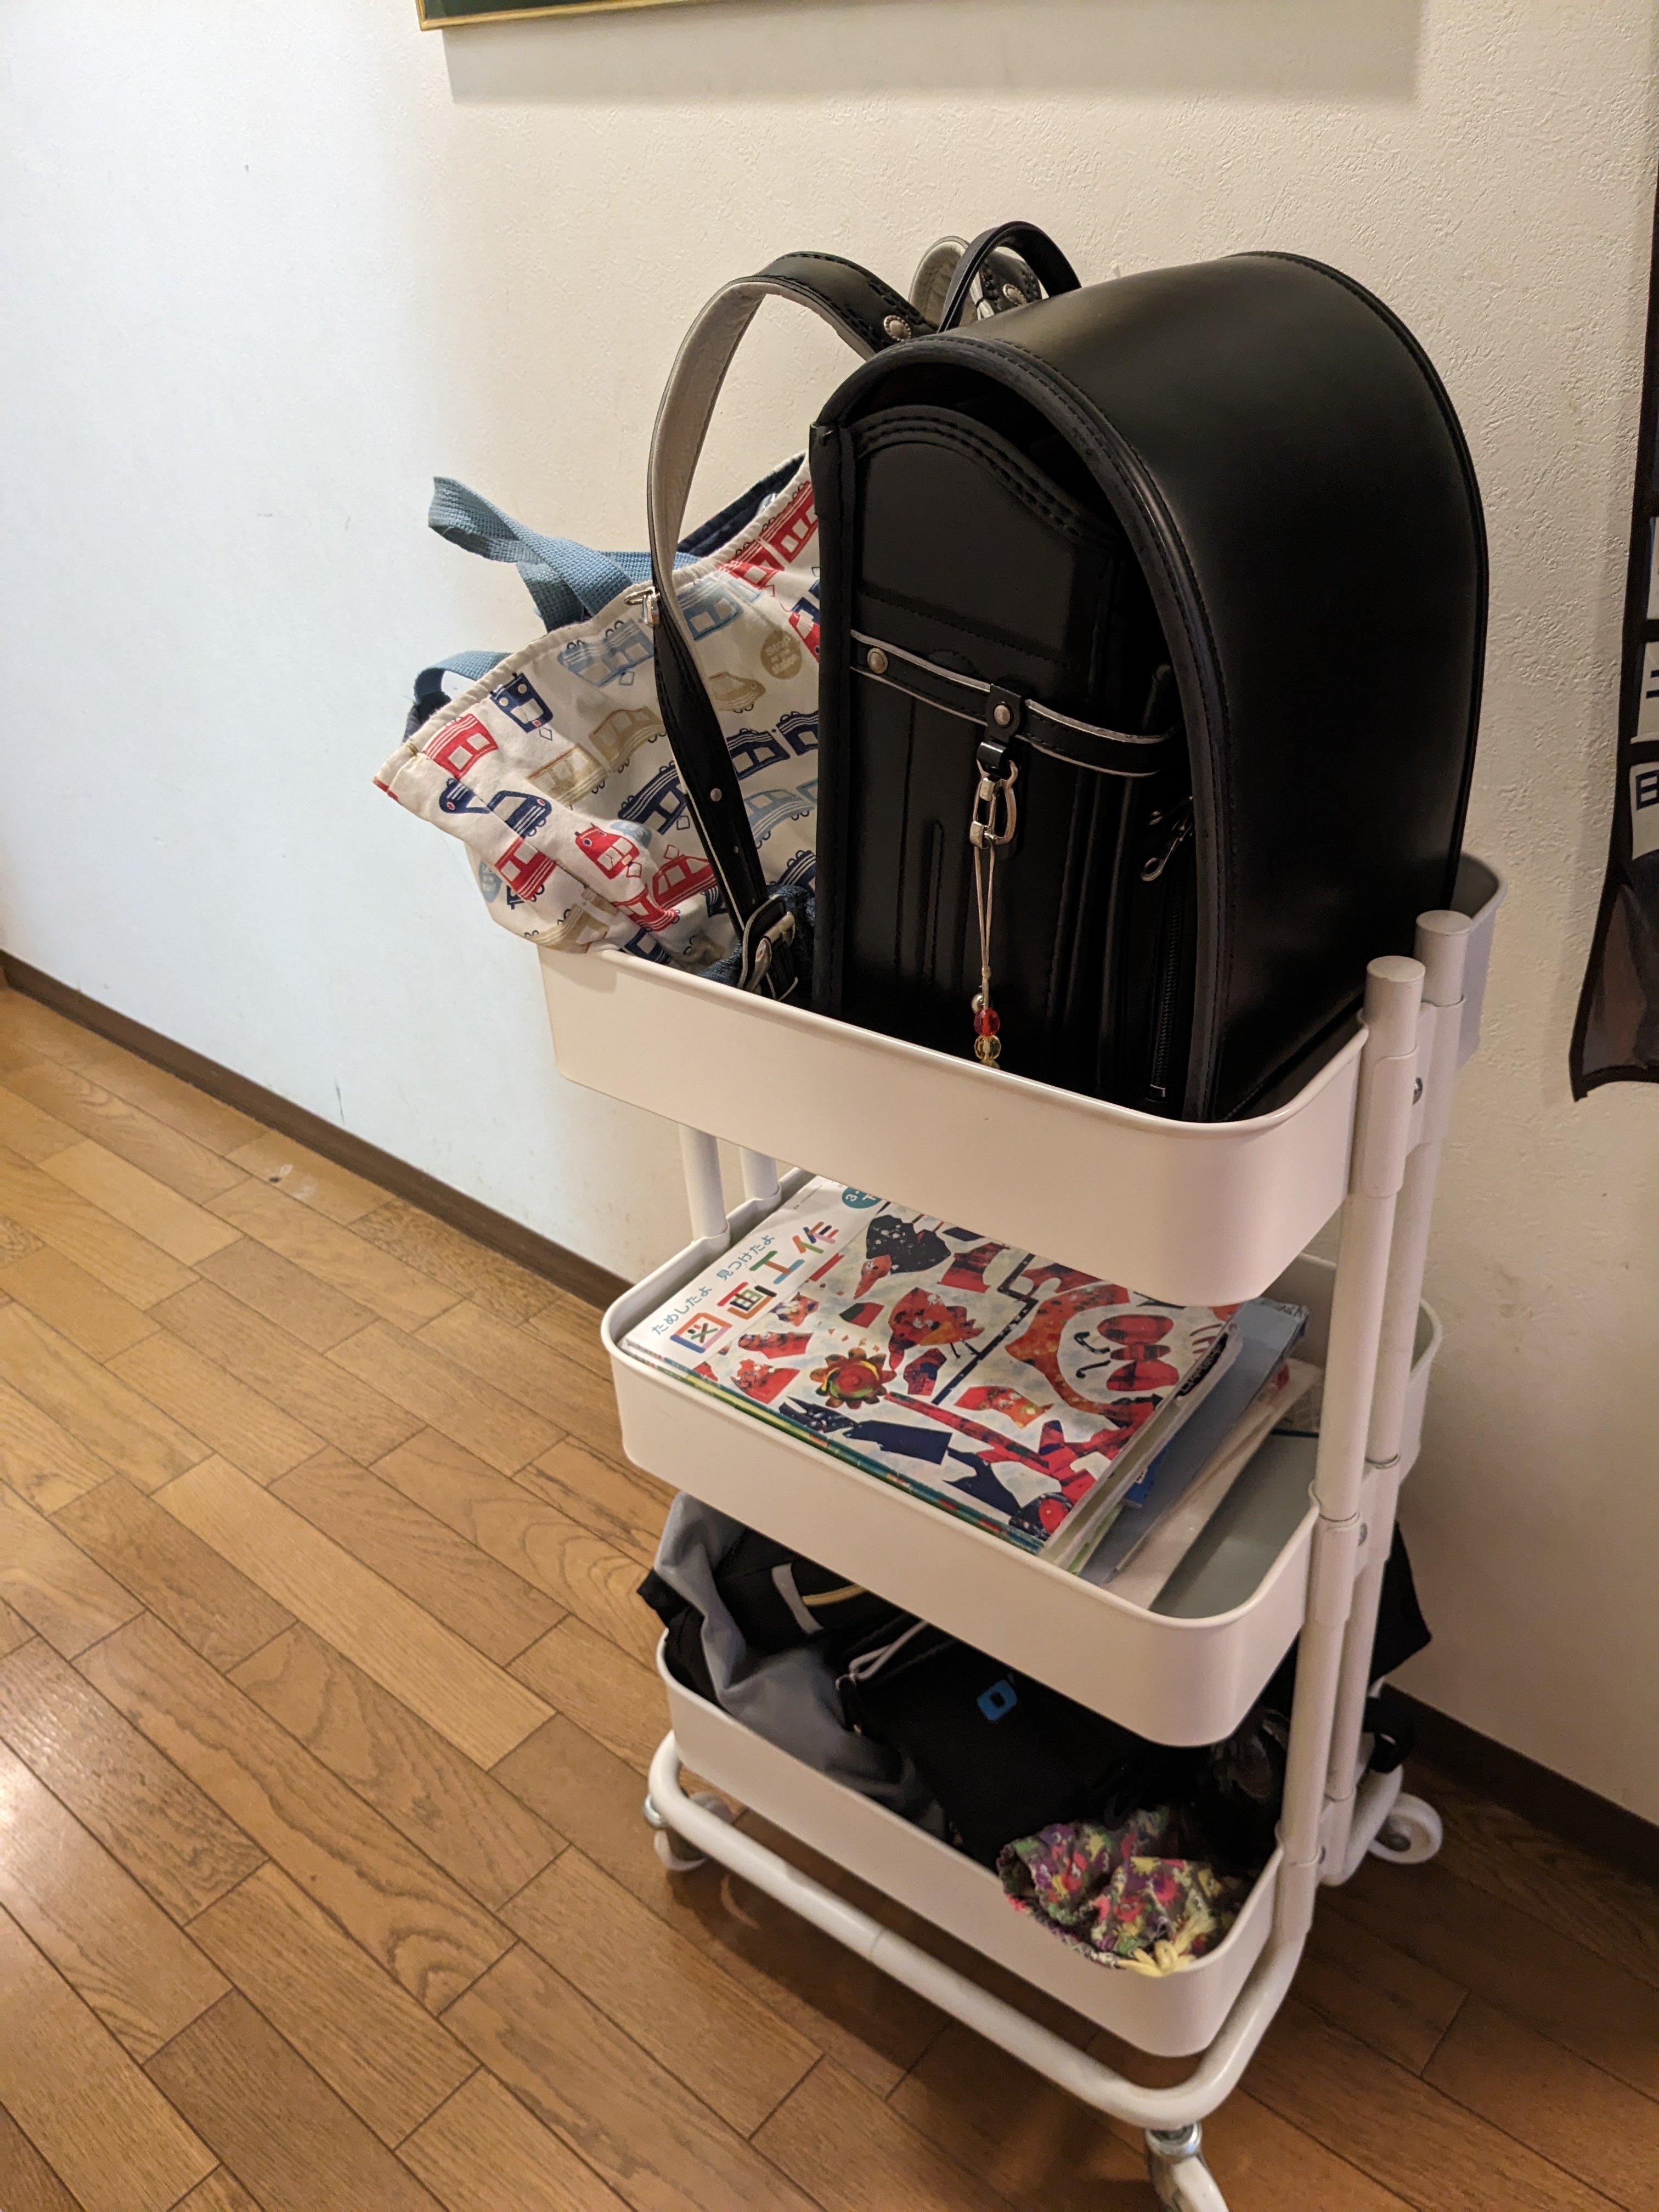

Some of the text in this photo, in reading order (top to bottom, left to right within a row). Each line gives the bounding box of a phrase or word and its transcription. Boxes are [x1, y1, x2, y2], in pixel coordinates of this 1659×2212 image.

[651, 1235, 776, 1335] ためしたよ 見つけたよ
[670, 1221, 840, 1353] 図画工作
